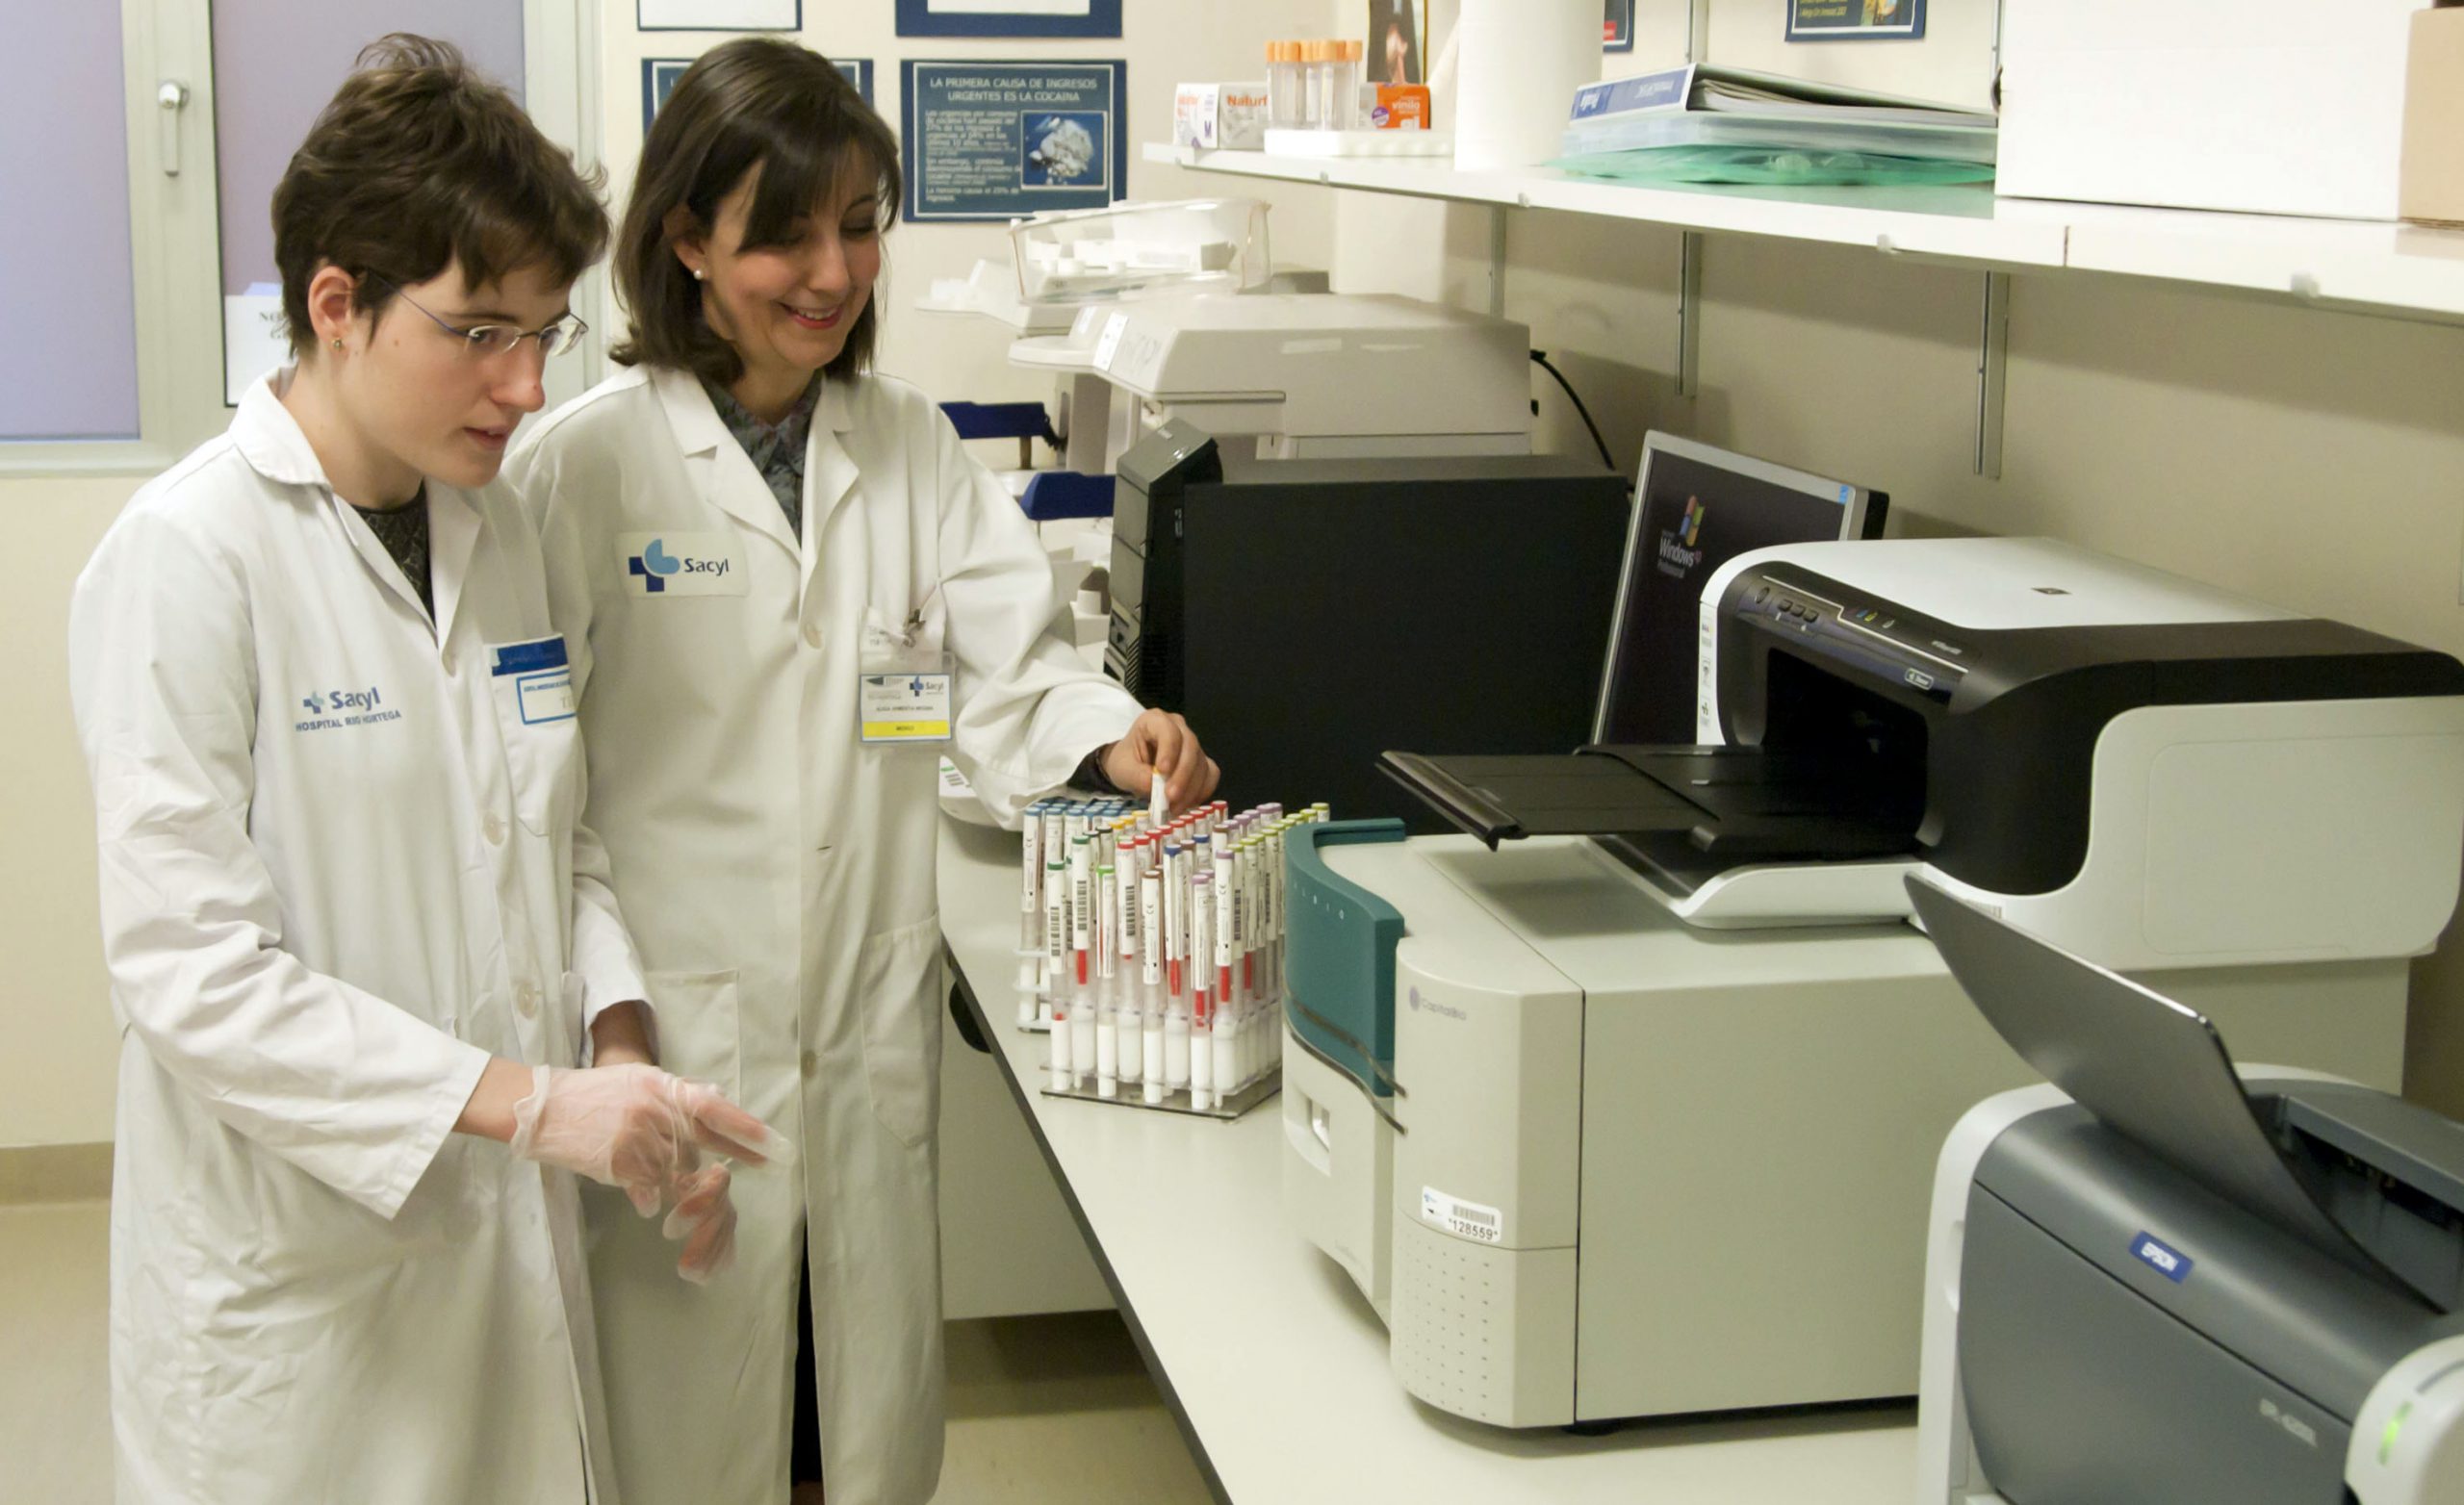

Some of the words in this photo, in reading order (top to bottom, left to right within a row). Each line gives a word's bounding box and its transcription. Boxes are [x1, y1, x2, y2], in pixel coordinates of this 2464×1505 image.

[930, 77, 942, 88] LA
[946, 77, 990, 88] PRIMERA
[993, 77, 1026, 89] CAUSA
[1029, 78, 1044, 89] DE
[1046, 78, 1098, 89] INGRESOS
[947, 91, 1002, 101] URGENTES
[1004, 91, 1016, 101] ES
[1019, 91, 1032, 101] LA
[1658, 538, 1694, 568] Windows
[683, 557, 730, 576] Sacyl
[329, 686, 381, 712] Sacyl
[295, 718, 344, 732] HOSPITAL
